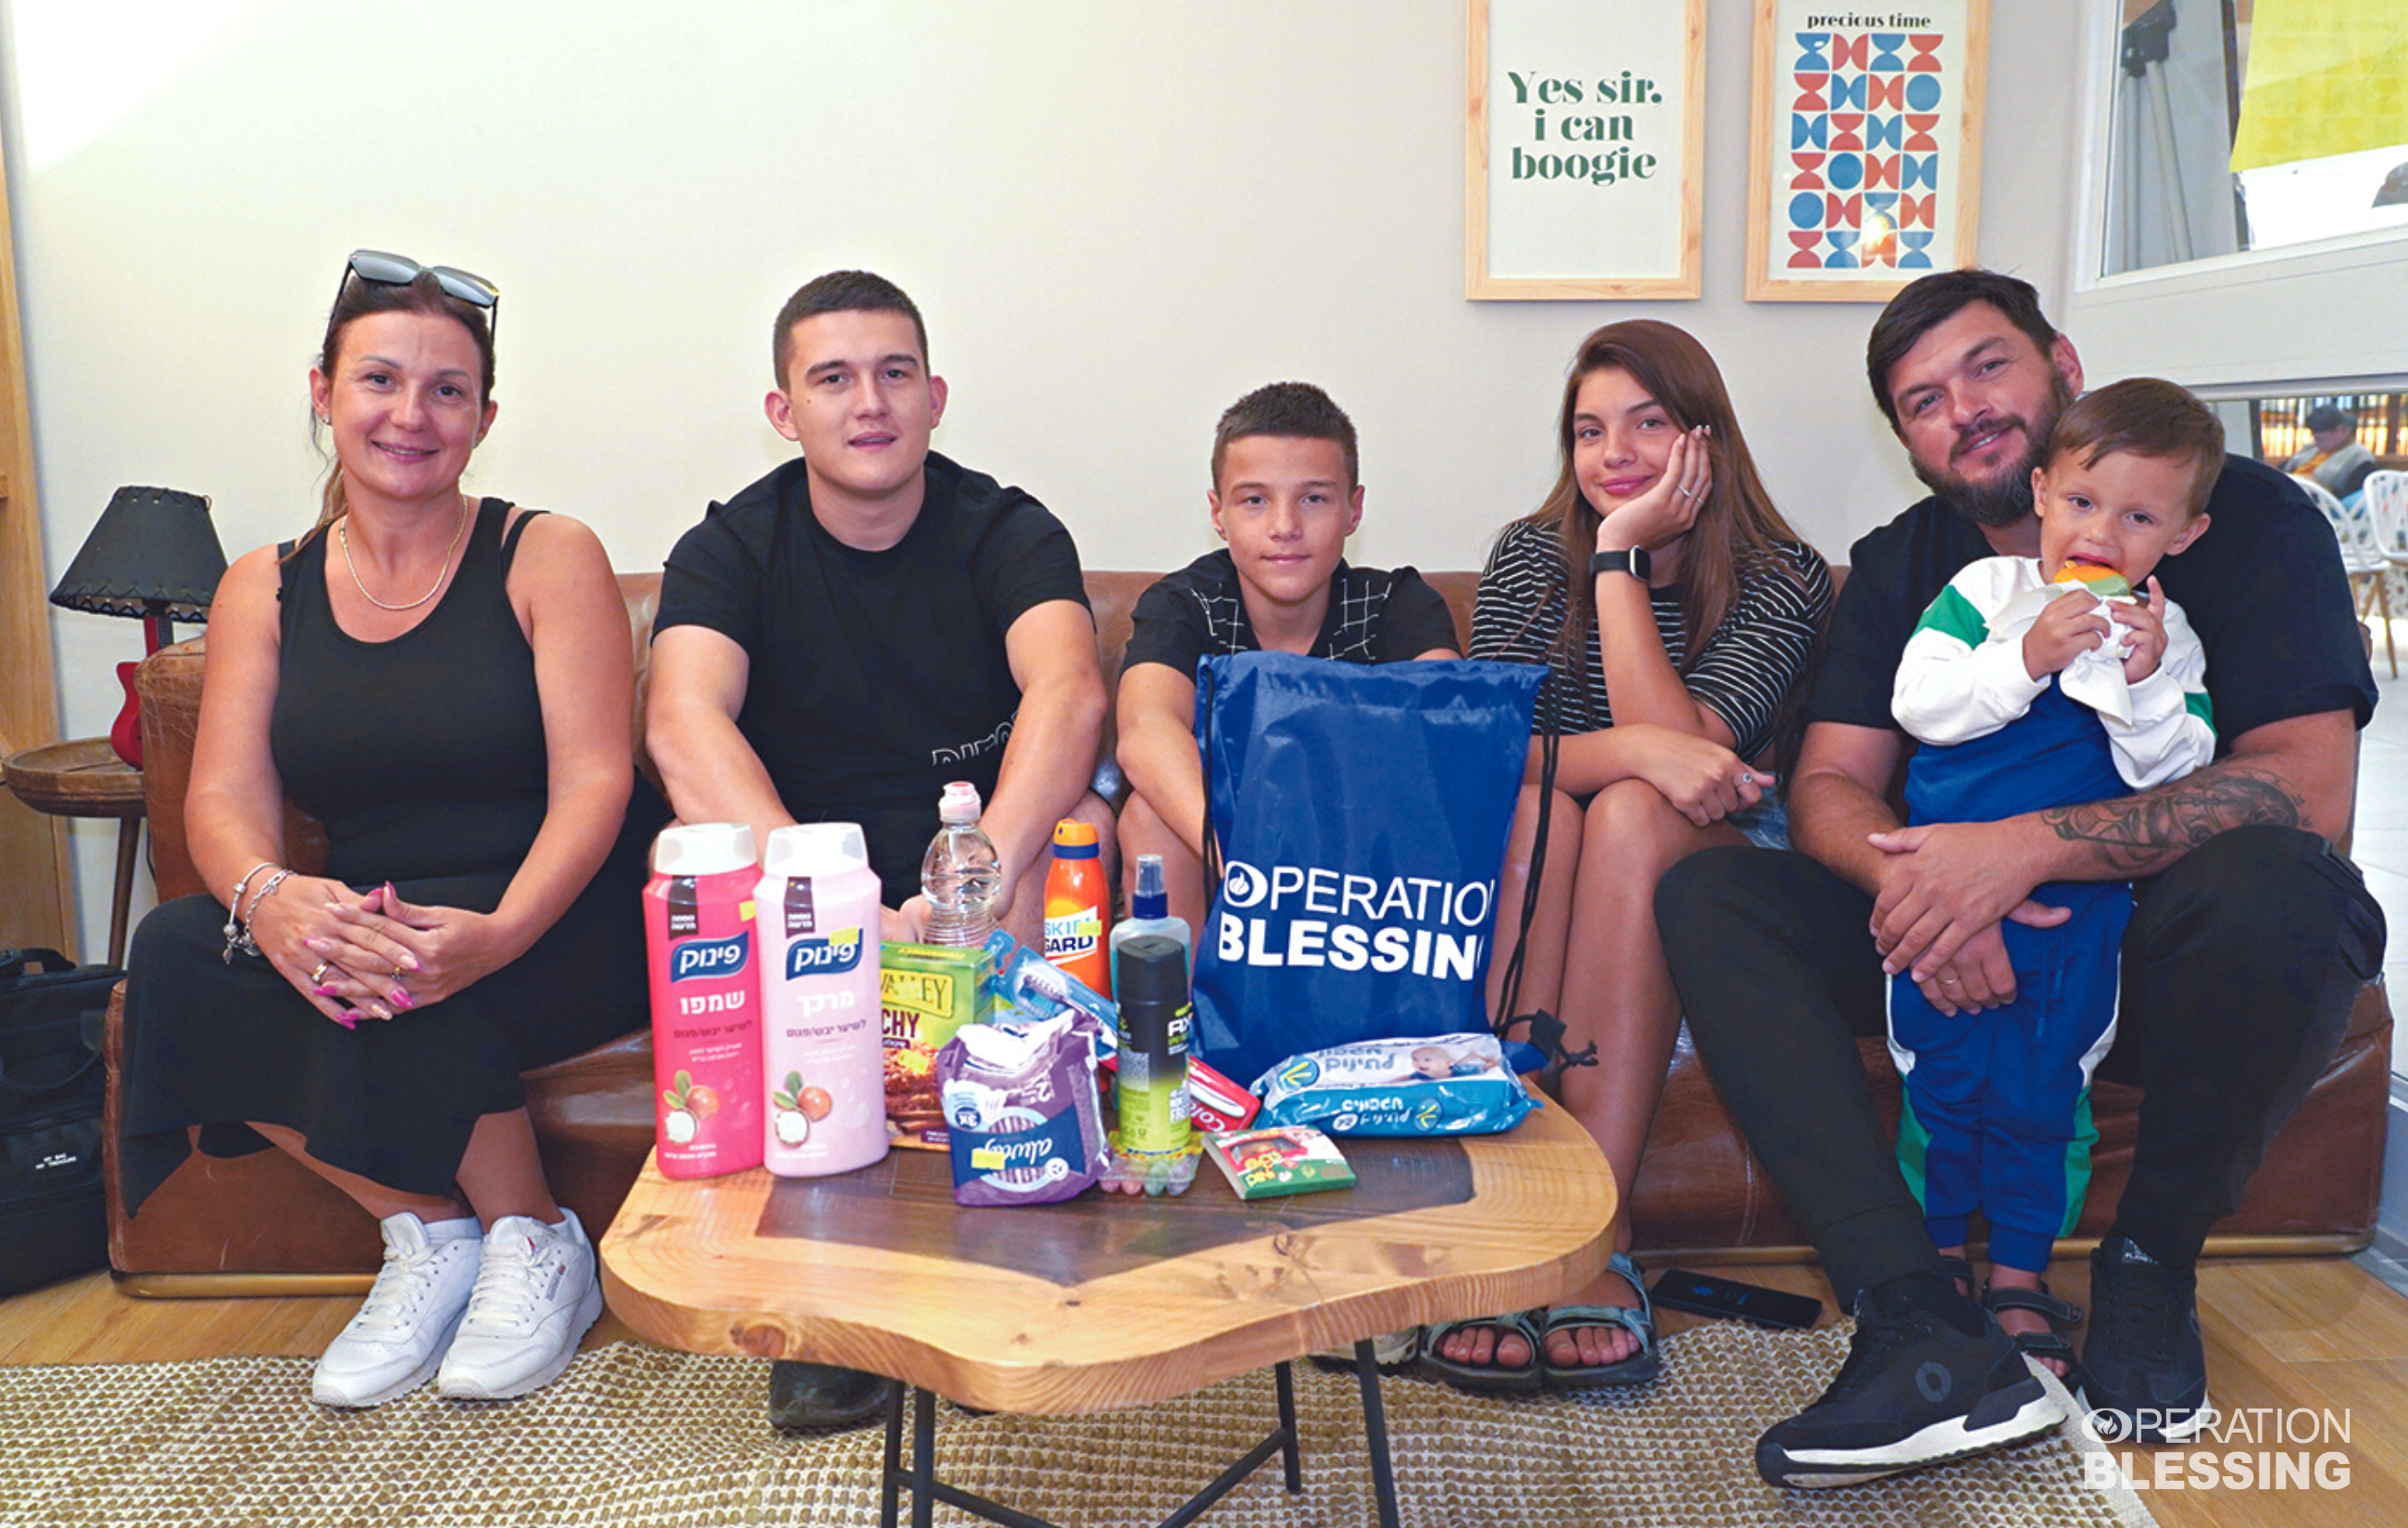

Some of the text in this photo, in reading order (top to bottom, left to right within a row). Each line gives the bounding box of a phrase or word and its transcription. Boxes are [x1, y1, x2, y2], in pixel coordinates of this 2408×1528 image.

[1808, 12, 1931, 30] precious time
[1508, 70, 1662, 104] Yes sir.
[1536, 108, 1633, 141] i can
[1512, 146, 1657, 185] boogie
[1223, 859, 1496, 927] OPERATIO
[680, 945, 741, 974] פינוק
[794, 943, 856, 972] פינוק
[1219, 911, 1484, 981] BLESSIN
[680, 989, 745, 1015] שמפו
[796, 990, 854, 1018] מרכך
